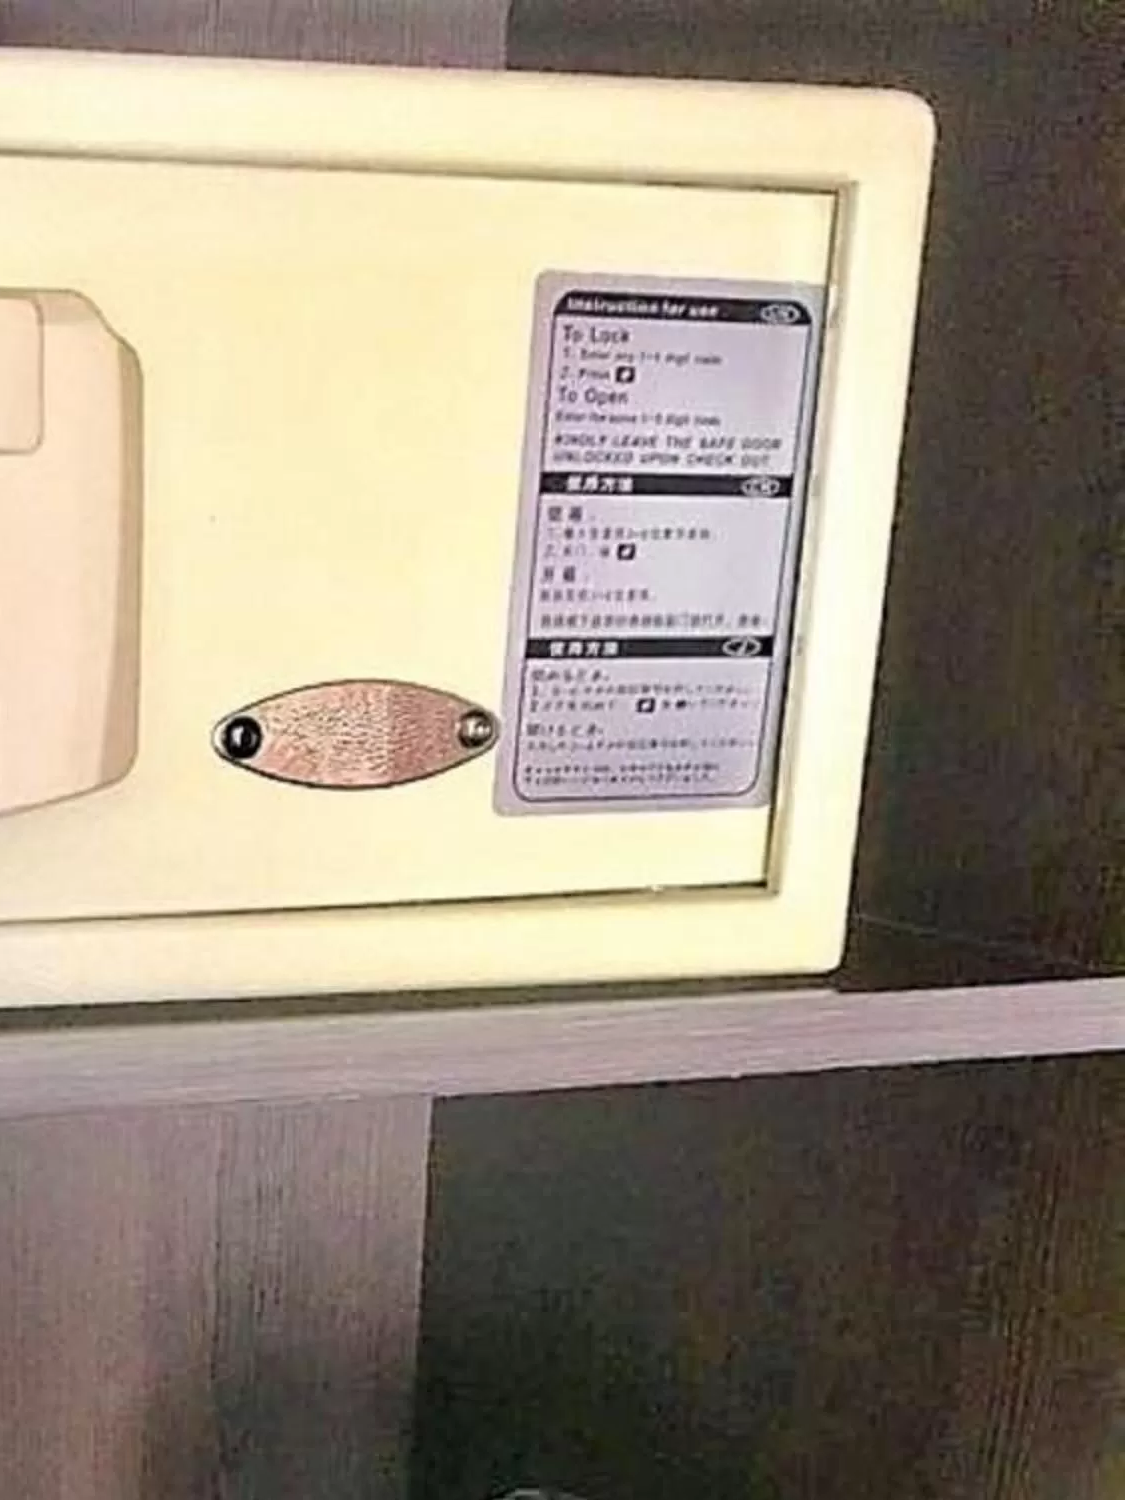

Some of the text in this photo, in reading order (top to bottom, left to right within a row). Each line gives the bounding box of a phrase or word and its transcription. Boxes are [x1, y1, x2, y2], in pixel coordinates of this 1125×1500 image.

[563, 324, 631, 344] To Lock
[558, 386, 629, 406] To Open
